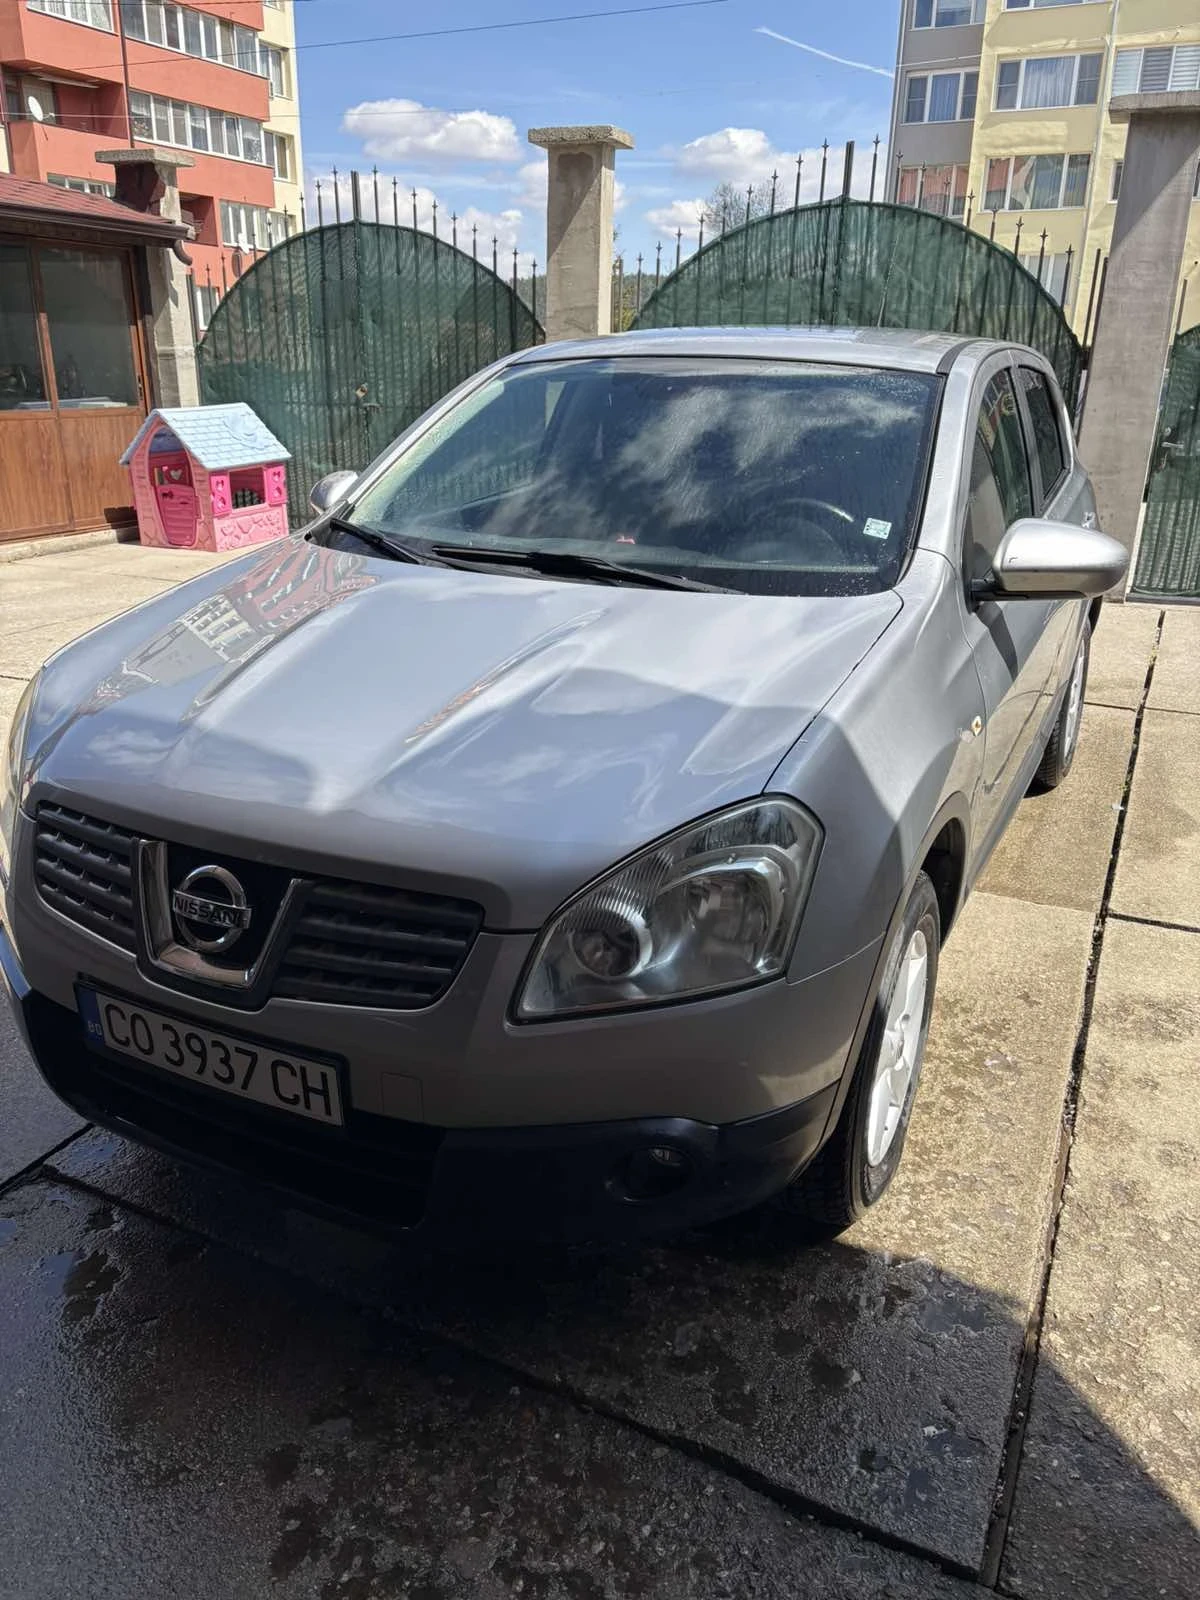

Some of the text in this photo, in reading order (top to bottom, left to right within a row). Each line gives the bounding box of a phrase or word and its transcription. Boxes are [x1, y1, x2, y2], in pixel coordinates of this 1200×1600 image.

[175, 896, 240, 926] NISSAN
[104, 1004, 332, 1116] CO 3937 CH
